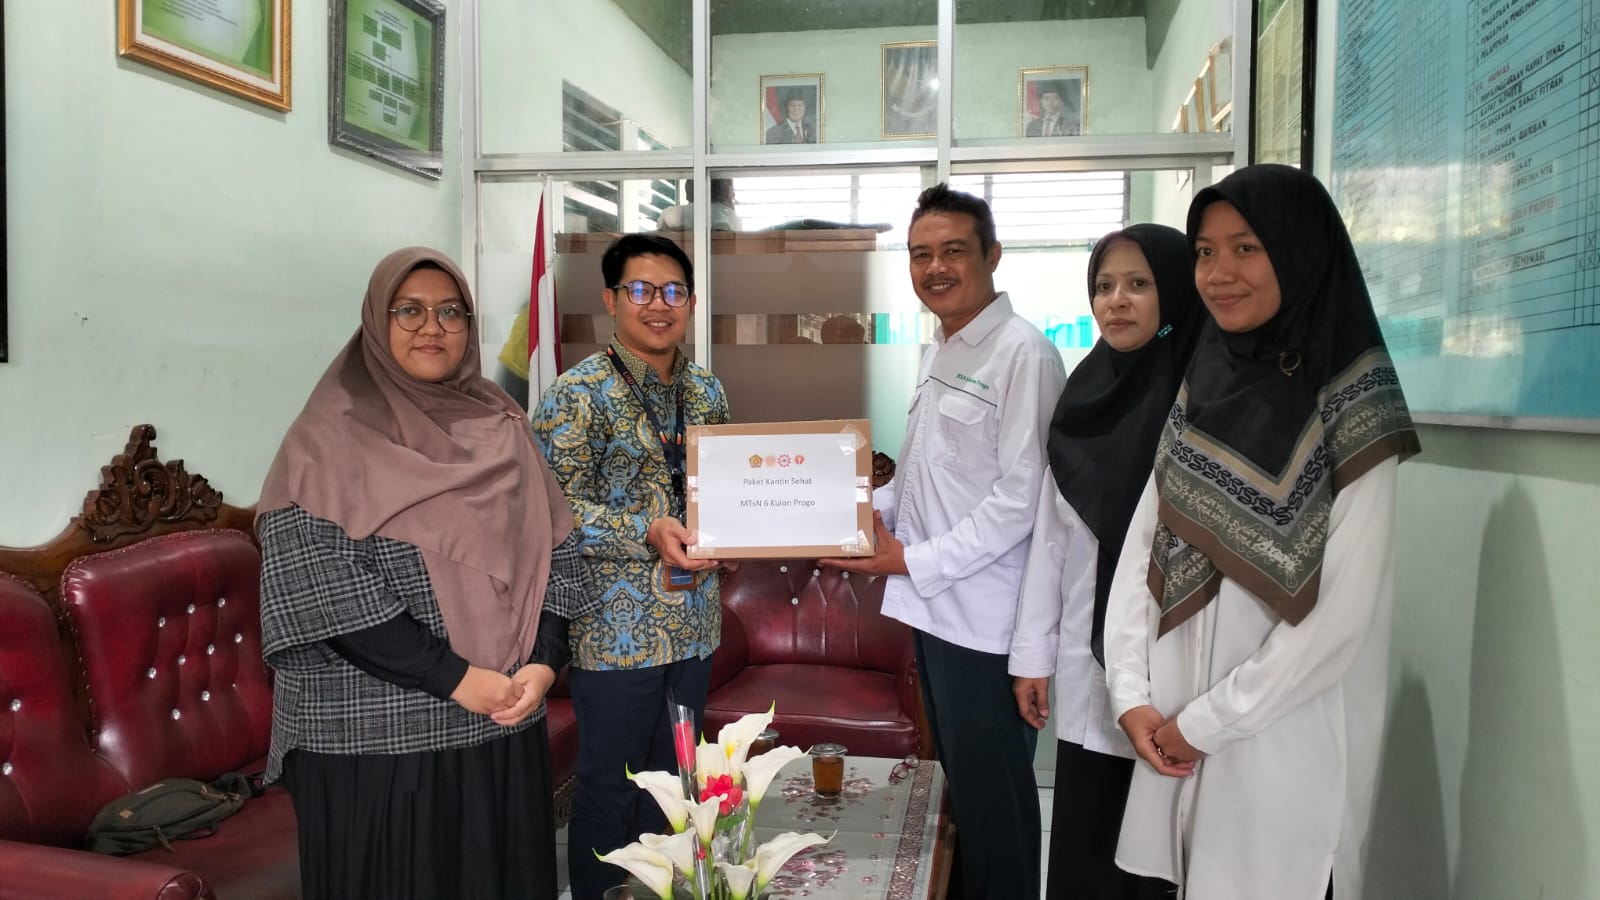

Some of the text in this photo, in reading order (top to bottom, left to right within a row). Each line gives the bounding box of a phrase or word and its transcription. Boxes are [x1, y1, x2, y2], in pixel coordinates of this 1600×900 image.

[743, 477, 813, 486] Paket Kantin Sehat
[740, 498, 816, 508] MTsN 6 Kulon Progo
